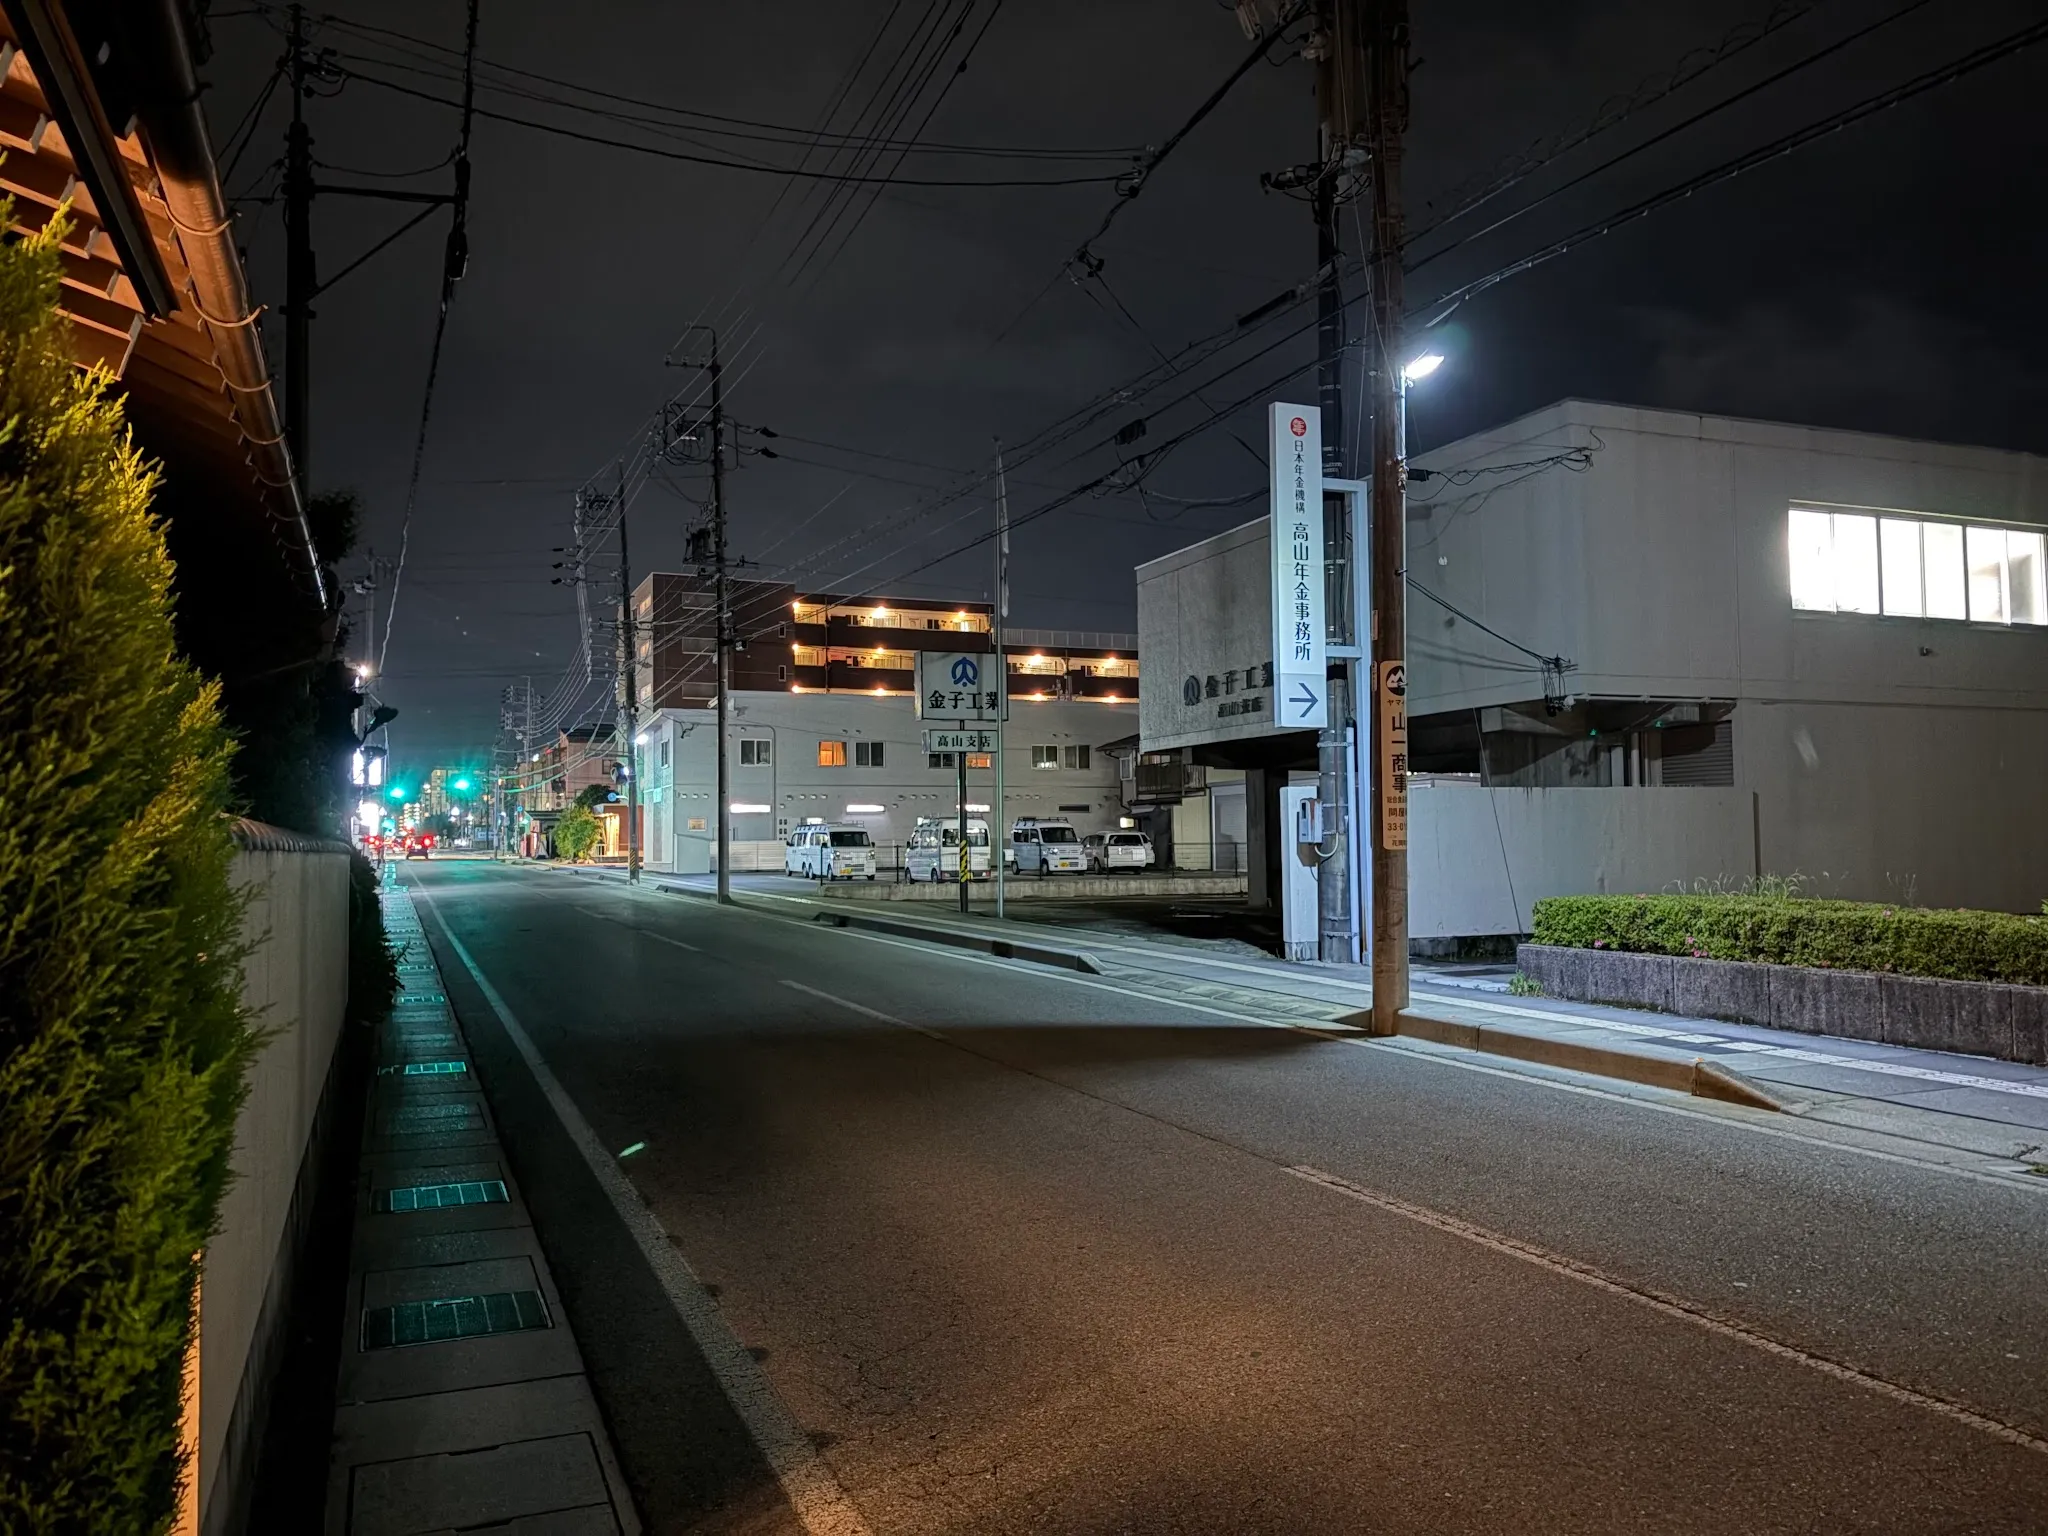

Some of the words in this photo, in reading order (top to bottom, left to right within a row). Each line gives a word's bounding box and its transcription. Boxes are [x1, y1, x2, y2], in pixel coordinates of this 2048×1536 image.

[1293, 440, 1305, 514] 日本年金機構
[1293, 522, 1311, 662] 高山年金事務所
[928, 689, 998, 711] 金子工業
[937, 734, 991, 748] 高山支店
[1391, 711, 1407, 793] 山一商事
[1387, 822, 1407, 831] 33-0
